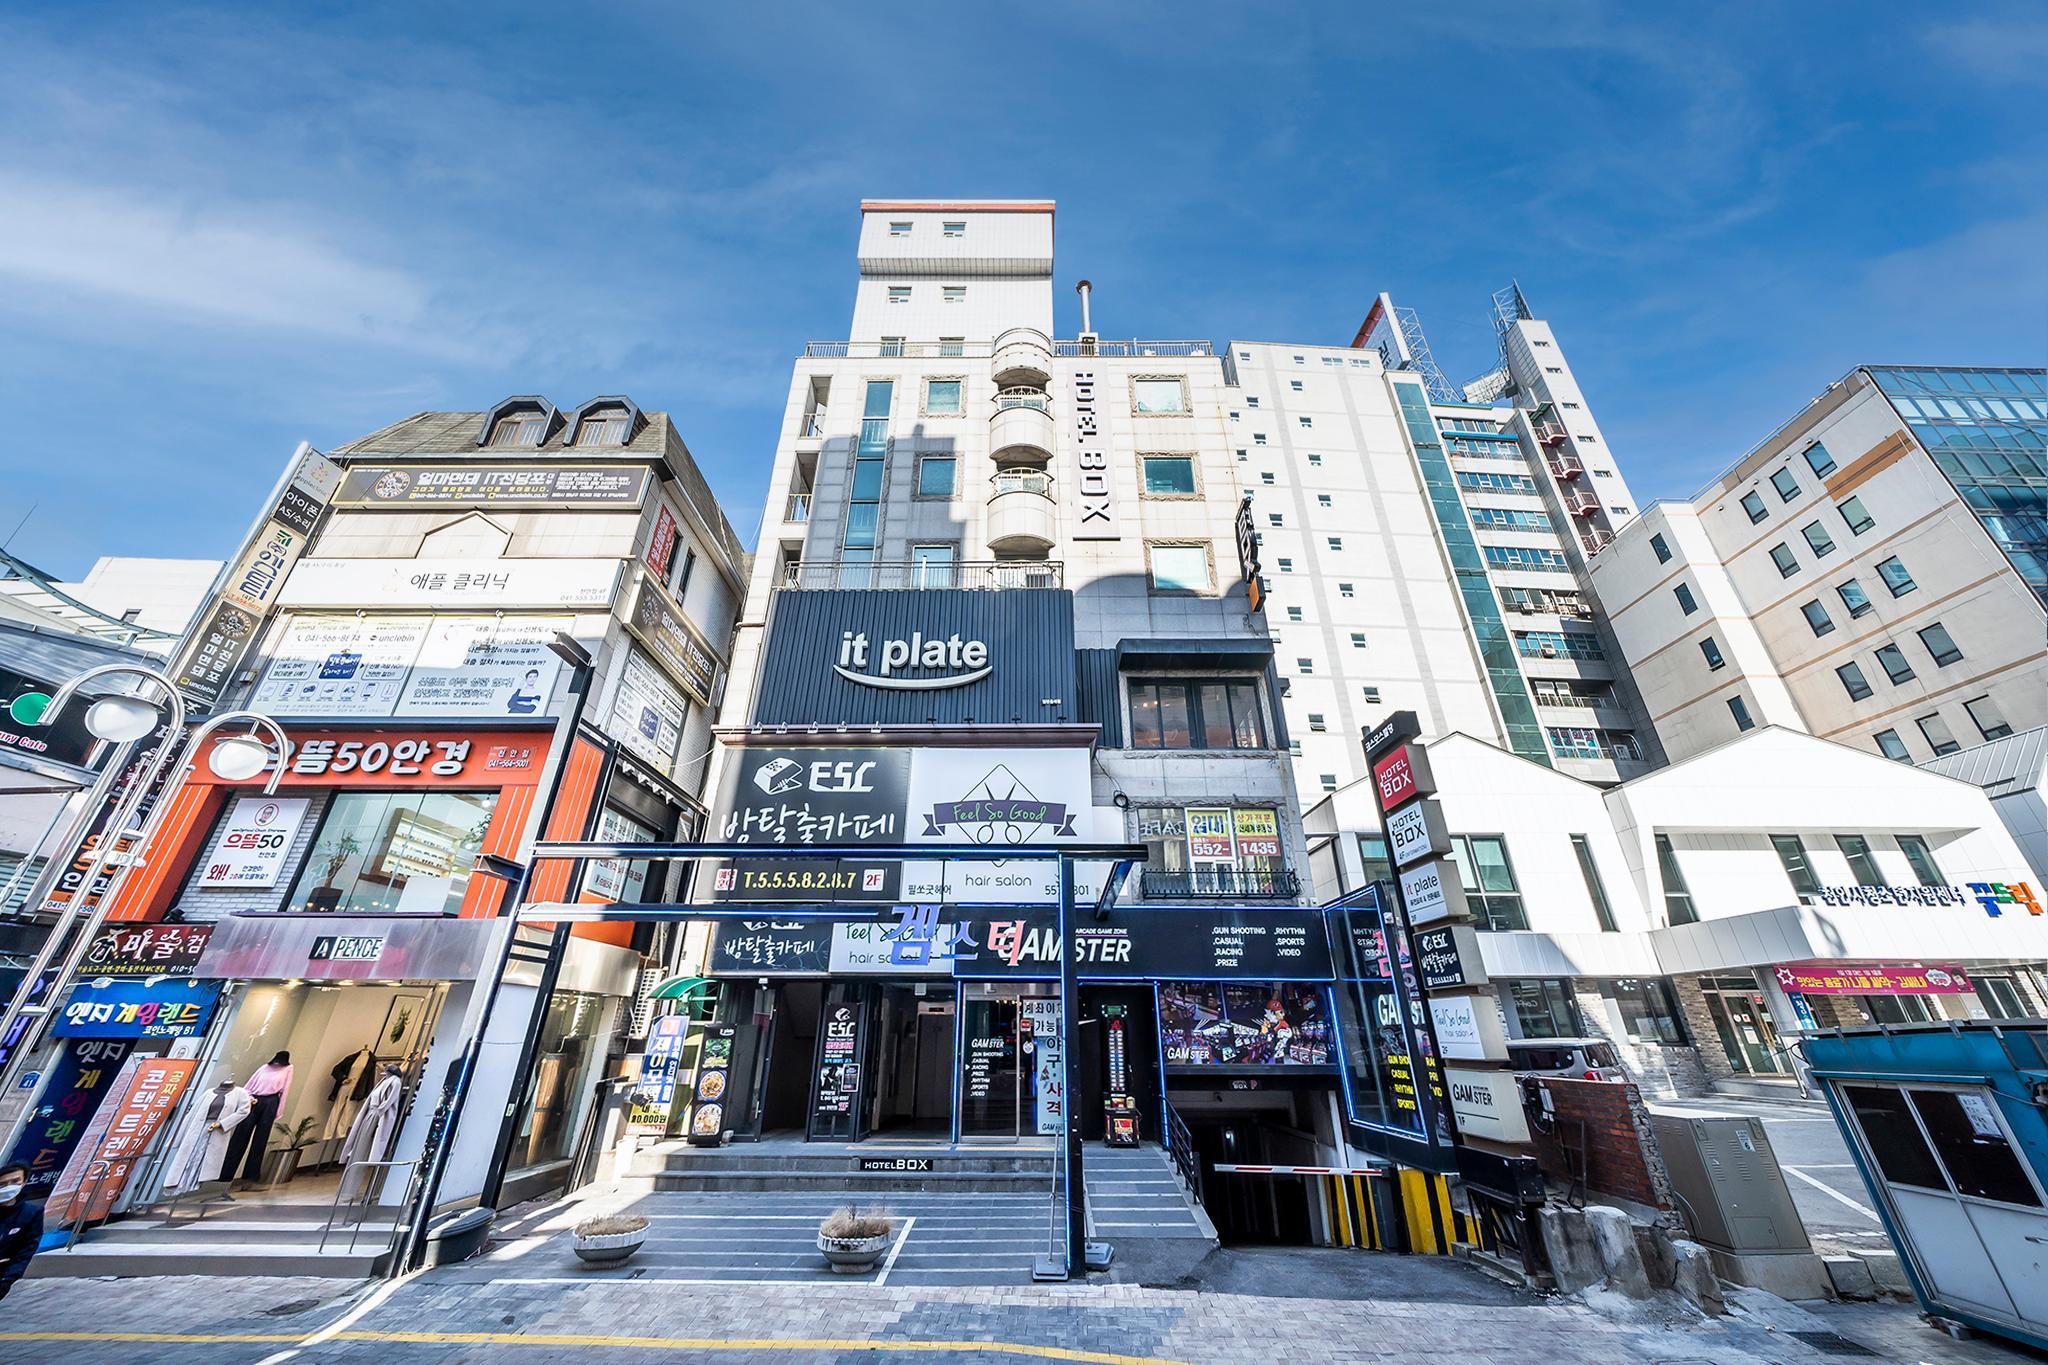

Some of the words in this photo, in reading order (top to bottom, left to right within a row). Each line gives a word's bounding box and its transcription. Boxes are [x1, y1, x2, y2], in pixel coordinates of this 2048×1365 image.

[1079, 450, 1111, 524] BOX
[286, 491, 319, 518] 아이폰
[278, 505, 311, 530] AS/수리
[410, 572, 447, 591] 애플
[453, 572, 510, 591] 클리닉
[839, 631, 868, 668] it
[881, 631, 989, 677] plate
[188, 680, 217, 696] unclebin
[19, 736, 47, 752] Cafe
[808, 761, 877, 793] ESC
[1380, 759, 1407, 780] HOTEL
[1383, 770, 1413, 799] BOX
[952, 803, 982, 823] Feel
[984, 802, 1004, 821] So
[1007, 803, 1048, 823] Good
[1391, 809, 1420, 830] HOTEL
[1190, 815, 1225, 834] 임대
[223, 833, 284, 850] 으뜸50
[1395, 822, 1426, 849] BOX
[1193, 843, 1230, 856] 552-
[1240, 842, 1277, 855] 1435
[207, 863, 231, 881] 왜!
[865, 871, 882, 888] 2F
[965, 872, 992, 887] hair
[995, 872, 1032, 887] salon
[1405, 883, 1413, 897] it
[1414, 873, 1438, 896] plate
[1819, 885, 1966, 907] 천안시청소년지원센터
[887, 903, 1028, 967] 겜스터
[1230, 927, 1267, 935] SHOOTING
[121, 928, 183, 961] 마술
[724, 934, 815, 967] 방탈출카페
[849, 951, 873, 964] hair
[66, 1001, 115, 1026] 엣지
[114, 1001, 202, 1026] 게임랜드
[183, 1025, 195, 1035] B1
[1035, 1019, 1056, 1033] 가능
[76, 1041, 127, 1064] 엣지
[22, 1079, 33, 1088] 41
[1391, 1069, 1411, 1080] CASUAL
[153, 1070, 185, 1109] 공짜로
[1397, 1099, 1416, 1111] SPORTS
[1457, 1115, 1466, 1127] 1F
[1745, 1142, 1751, 1151] 6
